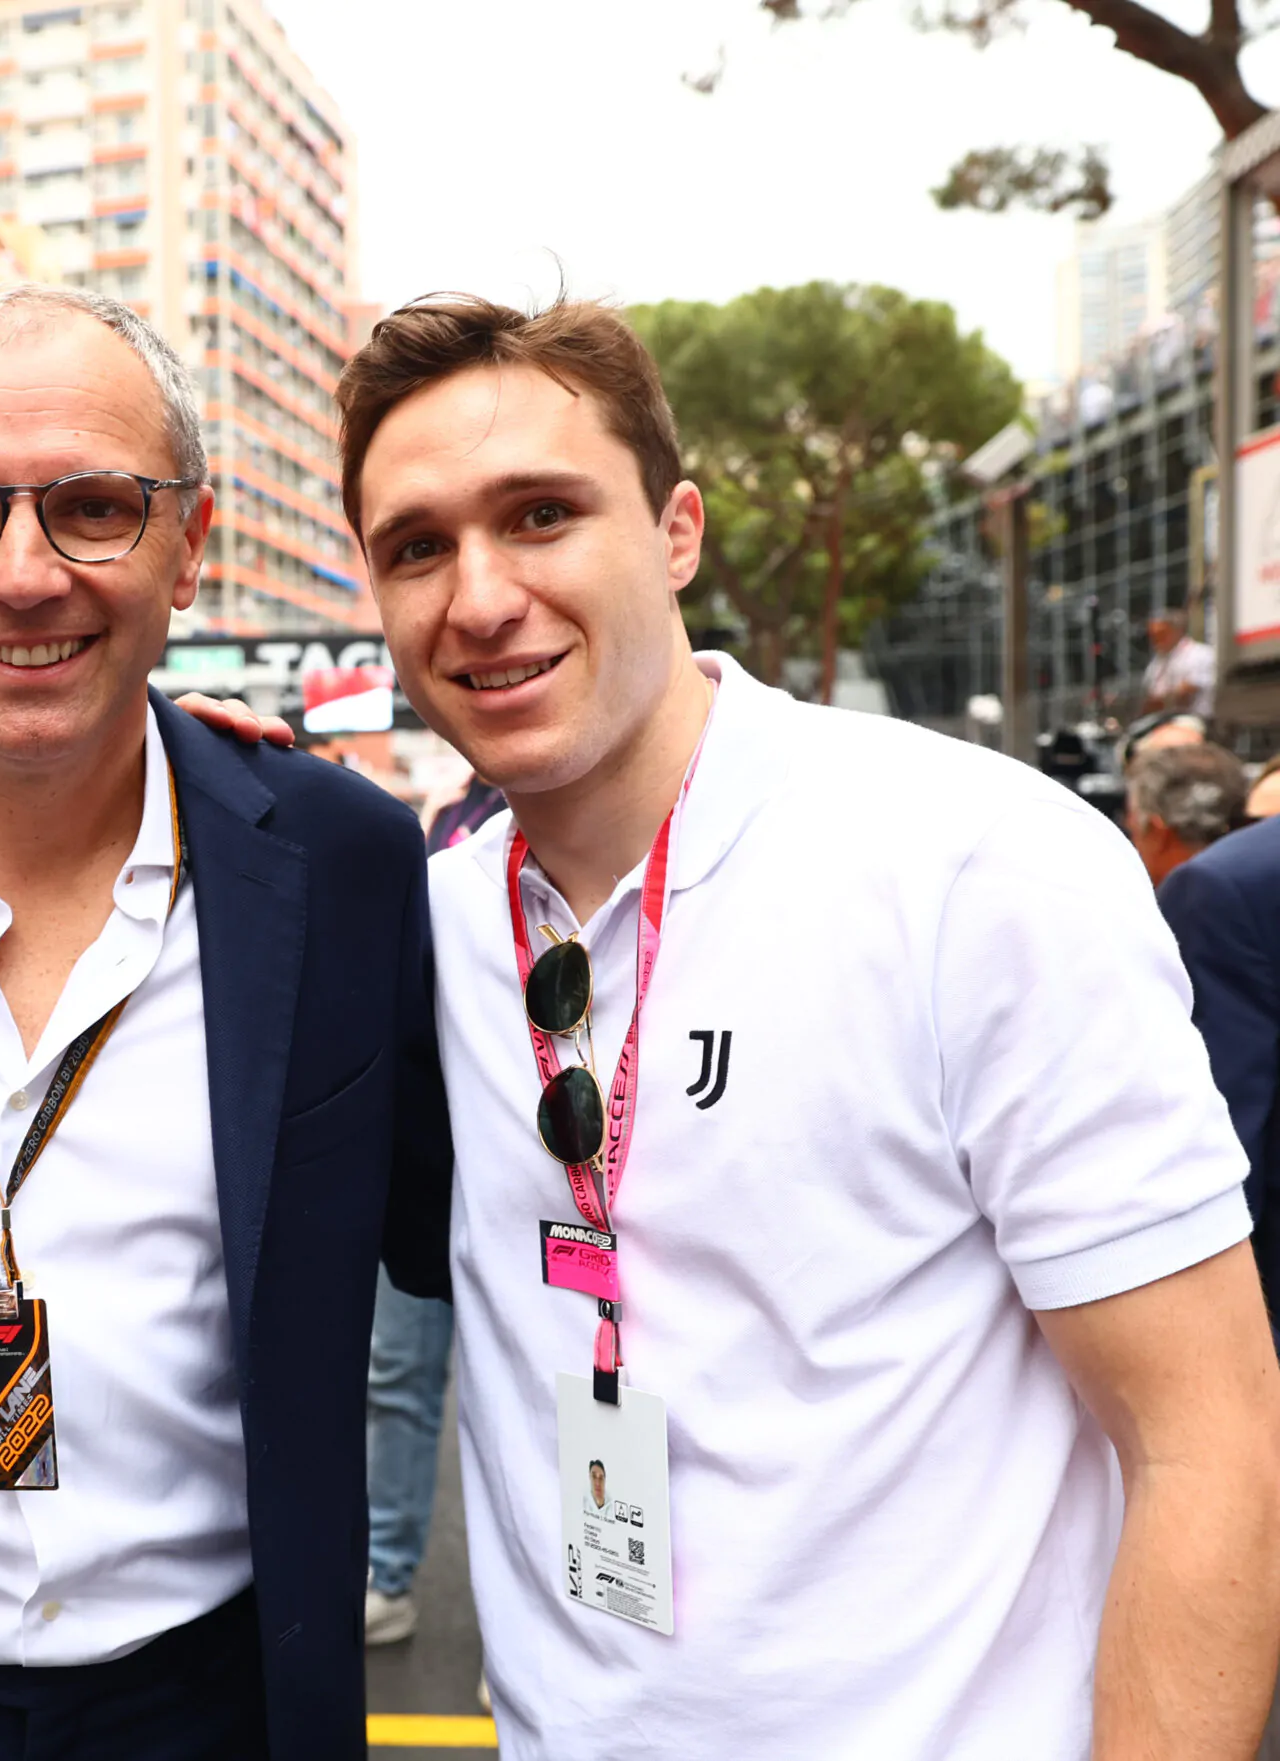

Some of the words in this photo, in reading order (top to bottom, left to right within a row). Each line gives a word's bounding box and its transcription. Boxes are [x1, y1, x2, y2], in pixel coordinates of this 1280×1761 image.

[13, 1162, 26, 1188] NET
[24, 1130, 41, 1162] ZERO
[37, 1080, 65, 1131] CARBON
[60, 1063, 74, 1081] BY
[71, 1035, 91, 1066] 2030
[608, 1052, 629, 1164] ACCESS
[579, 1248, 611, 1267] GRID
[1, 1365, 42, 1424] LANE
[11, 1394, 34, 1423] TIMES
[1, 1393, 50, 1472] 2022
